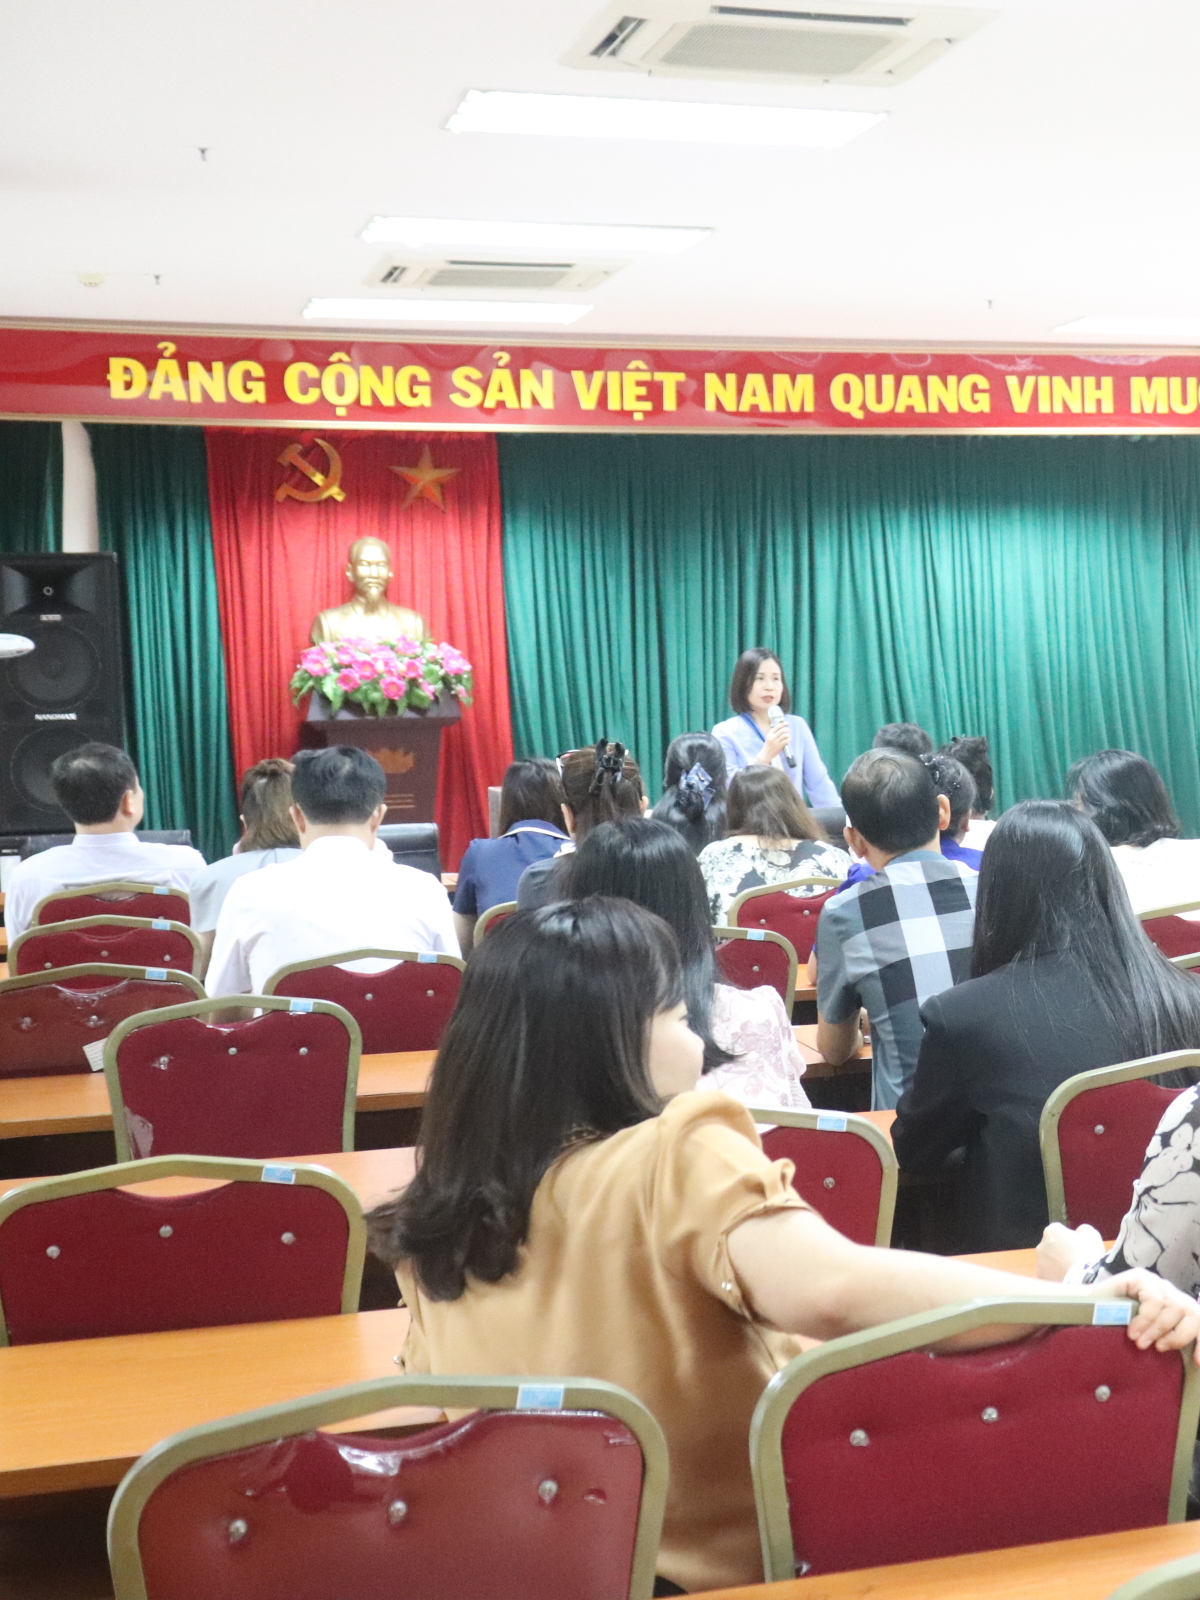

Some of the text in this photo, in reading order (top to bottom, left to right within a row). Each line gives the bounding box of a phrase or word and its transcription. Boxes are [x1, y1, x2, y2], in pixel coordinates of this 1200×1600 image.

[107, 342, 266, 403] ĐẢNG
[284, 352, 432, 417] CỘNG
[448, 351, 555, 410] SẢN
[571, 361, 686, 421] VIỆT
[704, 373, 814, 413] NAM
[829, 373, 991, 419] QUANG
[1006, 375, 1114, 414] VINH
